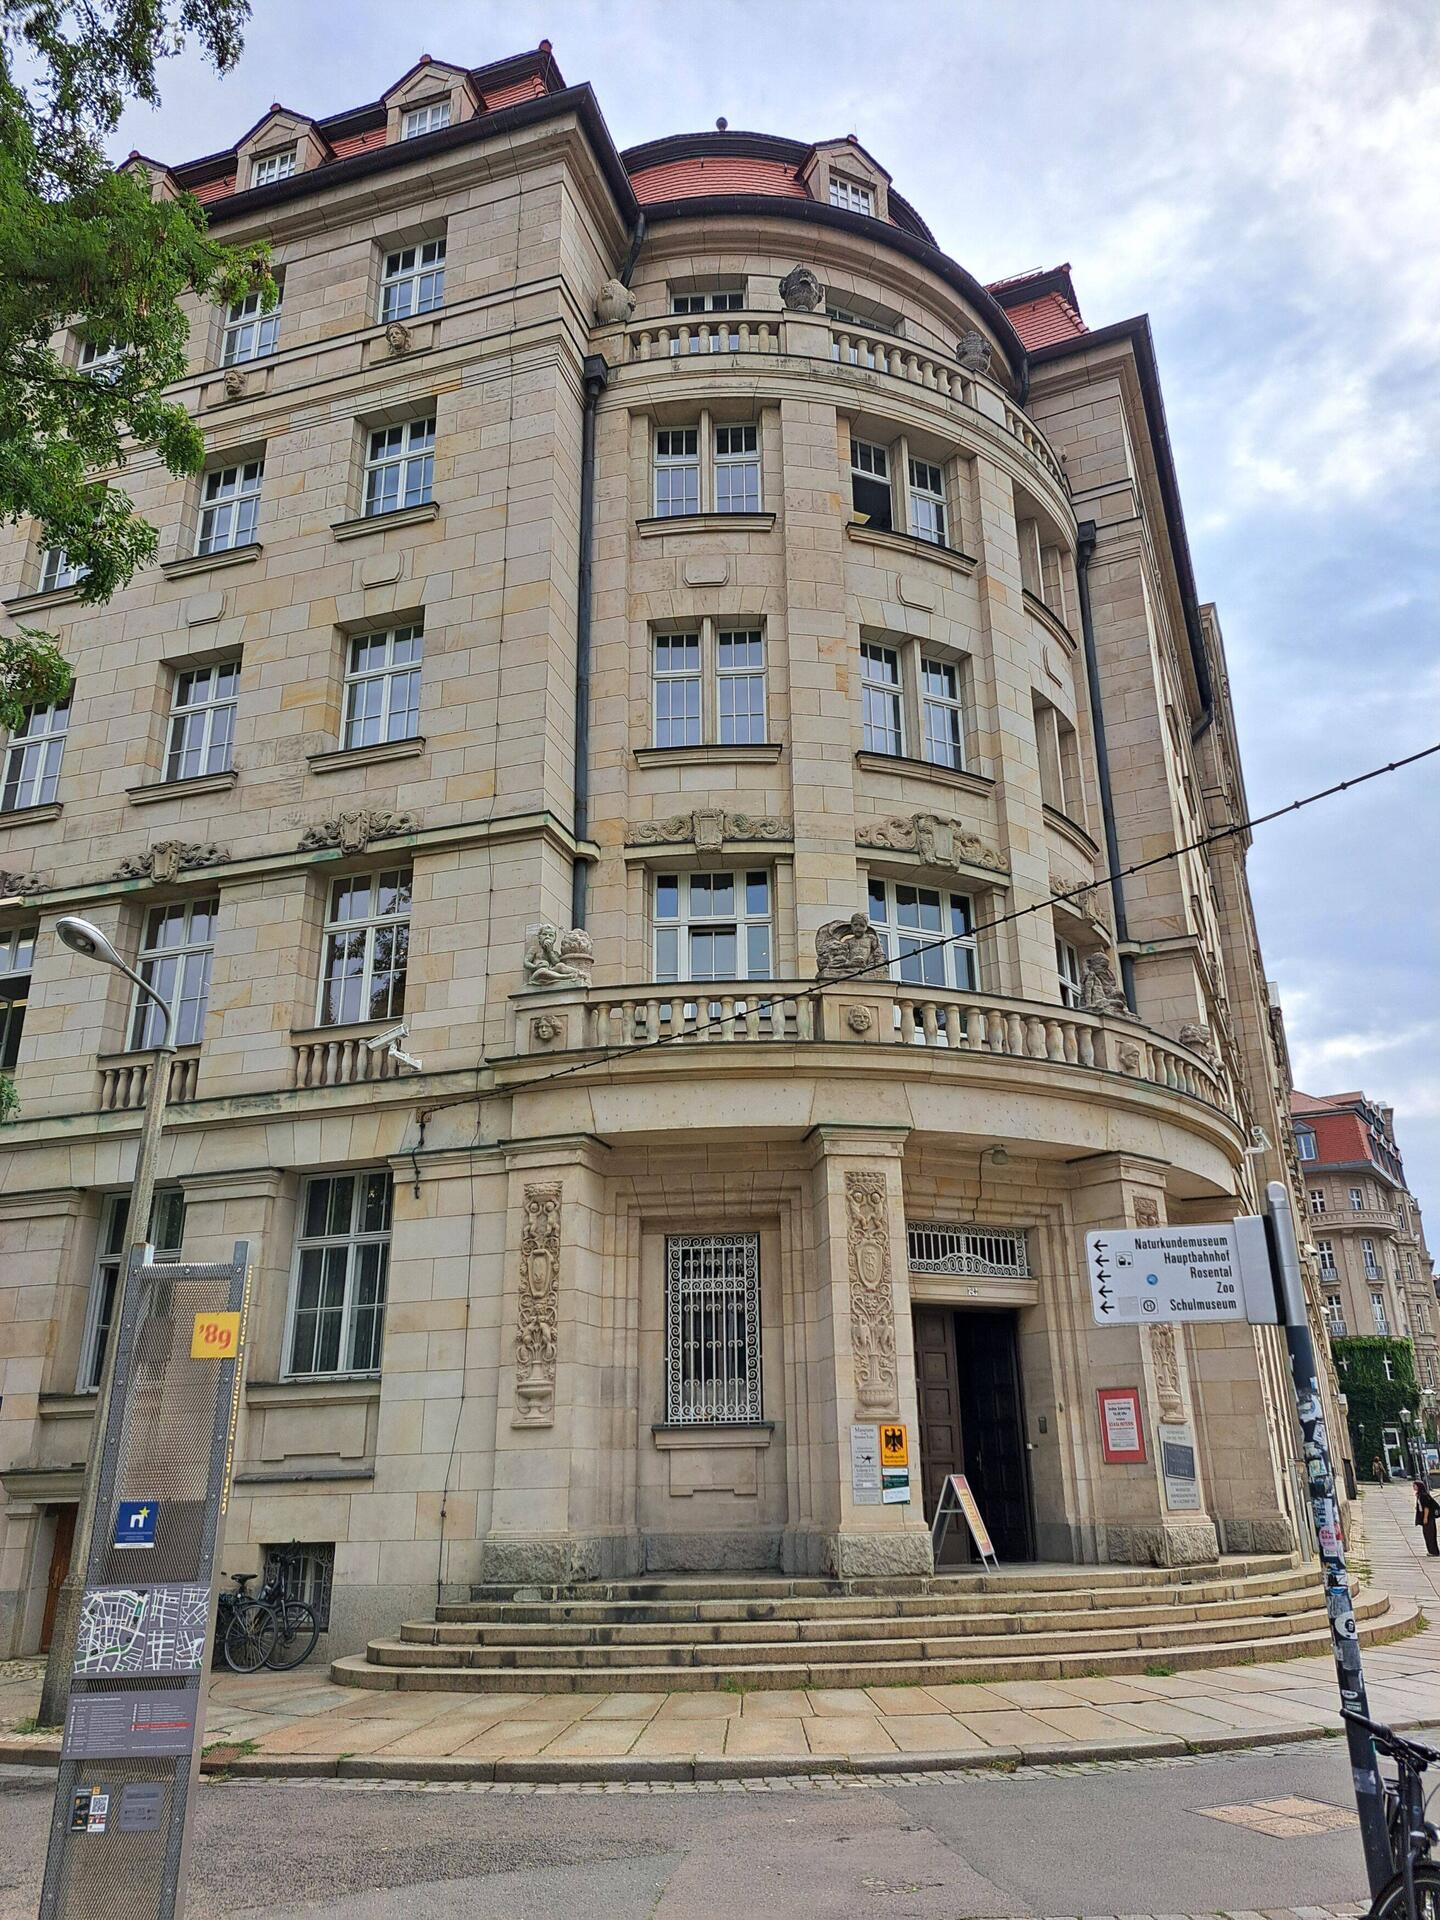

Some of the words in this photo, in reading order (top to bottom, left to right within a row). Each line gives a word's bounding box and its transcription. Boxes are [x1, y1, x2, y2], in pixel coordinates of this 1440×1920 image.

[1134, 1236, 1228, 1251] Naturkundemuseum
[1163, 1250, 1231, 1266] Hauptbahnhof
[1190, 1265, 1233, 1279] Rosental
[1216, 1281, 1235, 1294] Zoo
[1170, 1298, 1237, 1312] Schulmuseum
